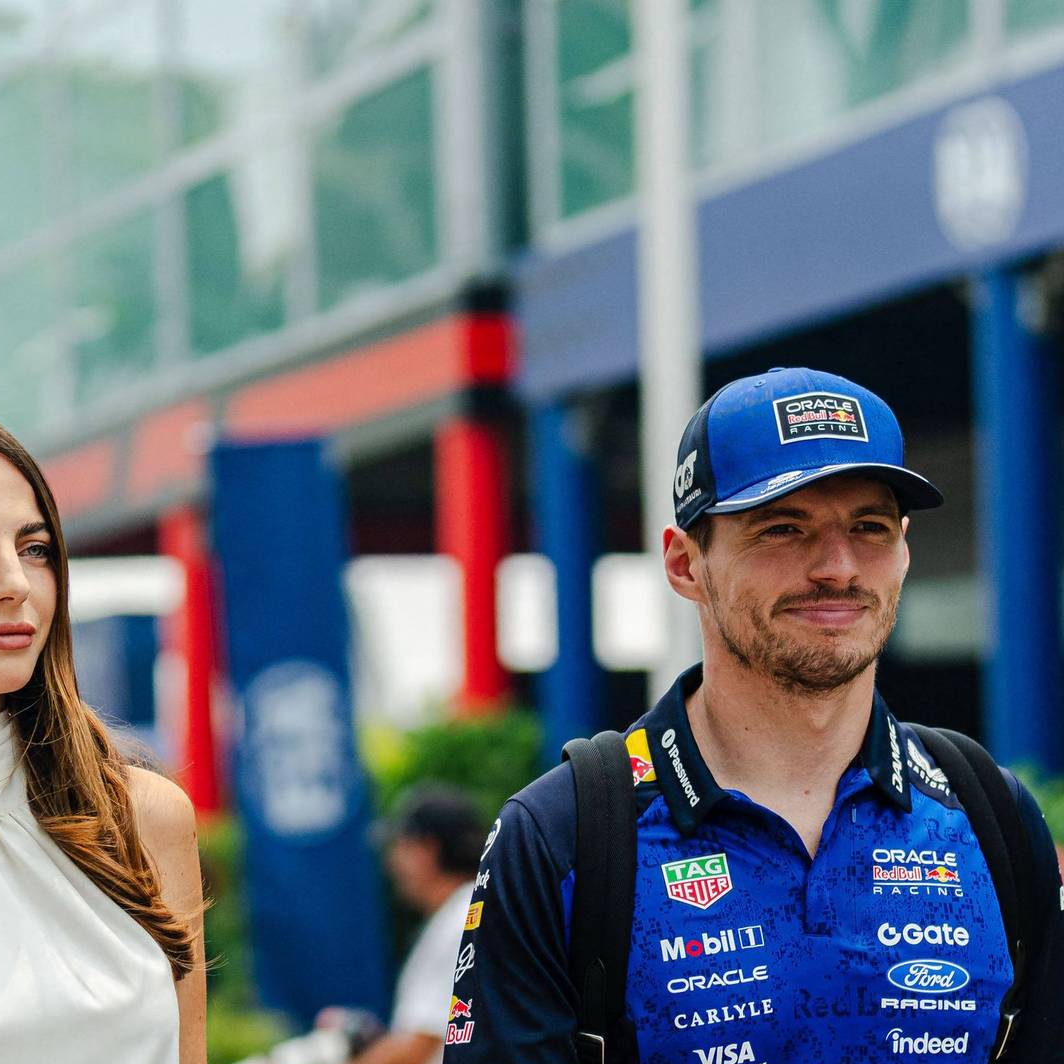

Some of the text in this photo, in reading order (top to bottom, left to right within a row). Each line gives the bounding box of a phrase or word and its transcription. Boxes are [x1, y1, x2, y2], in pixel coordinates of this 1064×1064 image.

[786, 399, 853, 413] ORACLE
[790, 424, 859, 435] RACING
[668, 744, 700, 808] 1Password
[668, 859, 723, 880] TAG
[872, 849, 957, 867] ORACLE
[671, 876, 729, 904] HEUER
[873, 886, 964, 897] RACING
[660, 929, 736, 962] Mobil
[902, 922, 970, 946] Gate
[667, 965, 769, 994] ORACLE
[904, 963, 955, 988] Ford
[674, 999, 774, 1029] CARLYLE
[880, 998, 977, 1011] RACING
[445, 1021, 475, 1045] Bull
[890, 1030, 970, 1055] indeed
